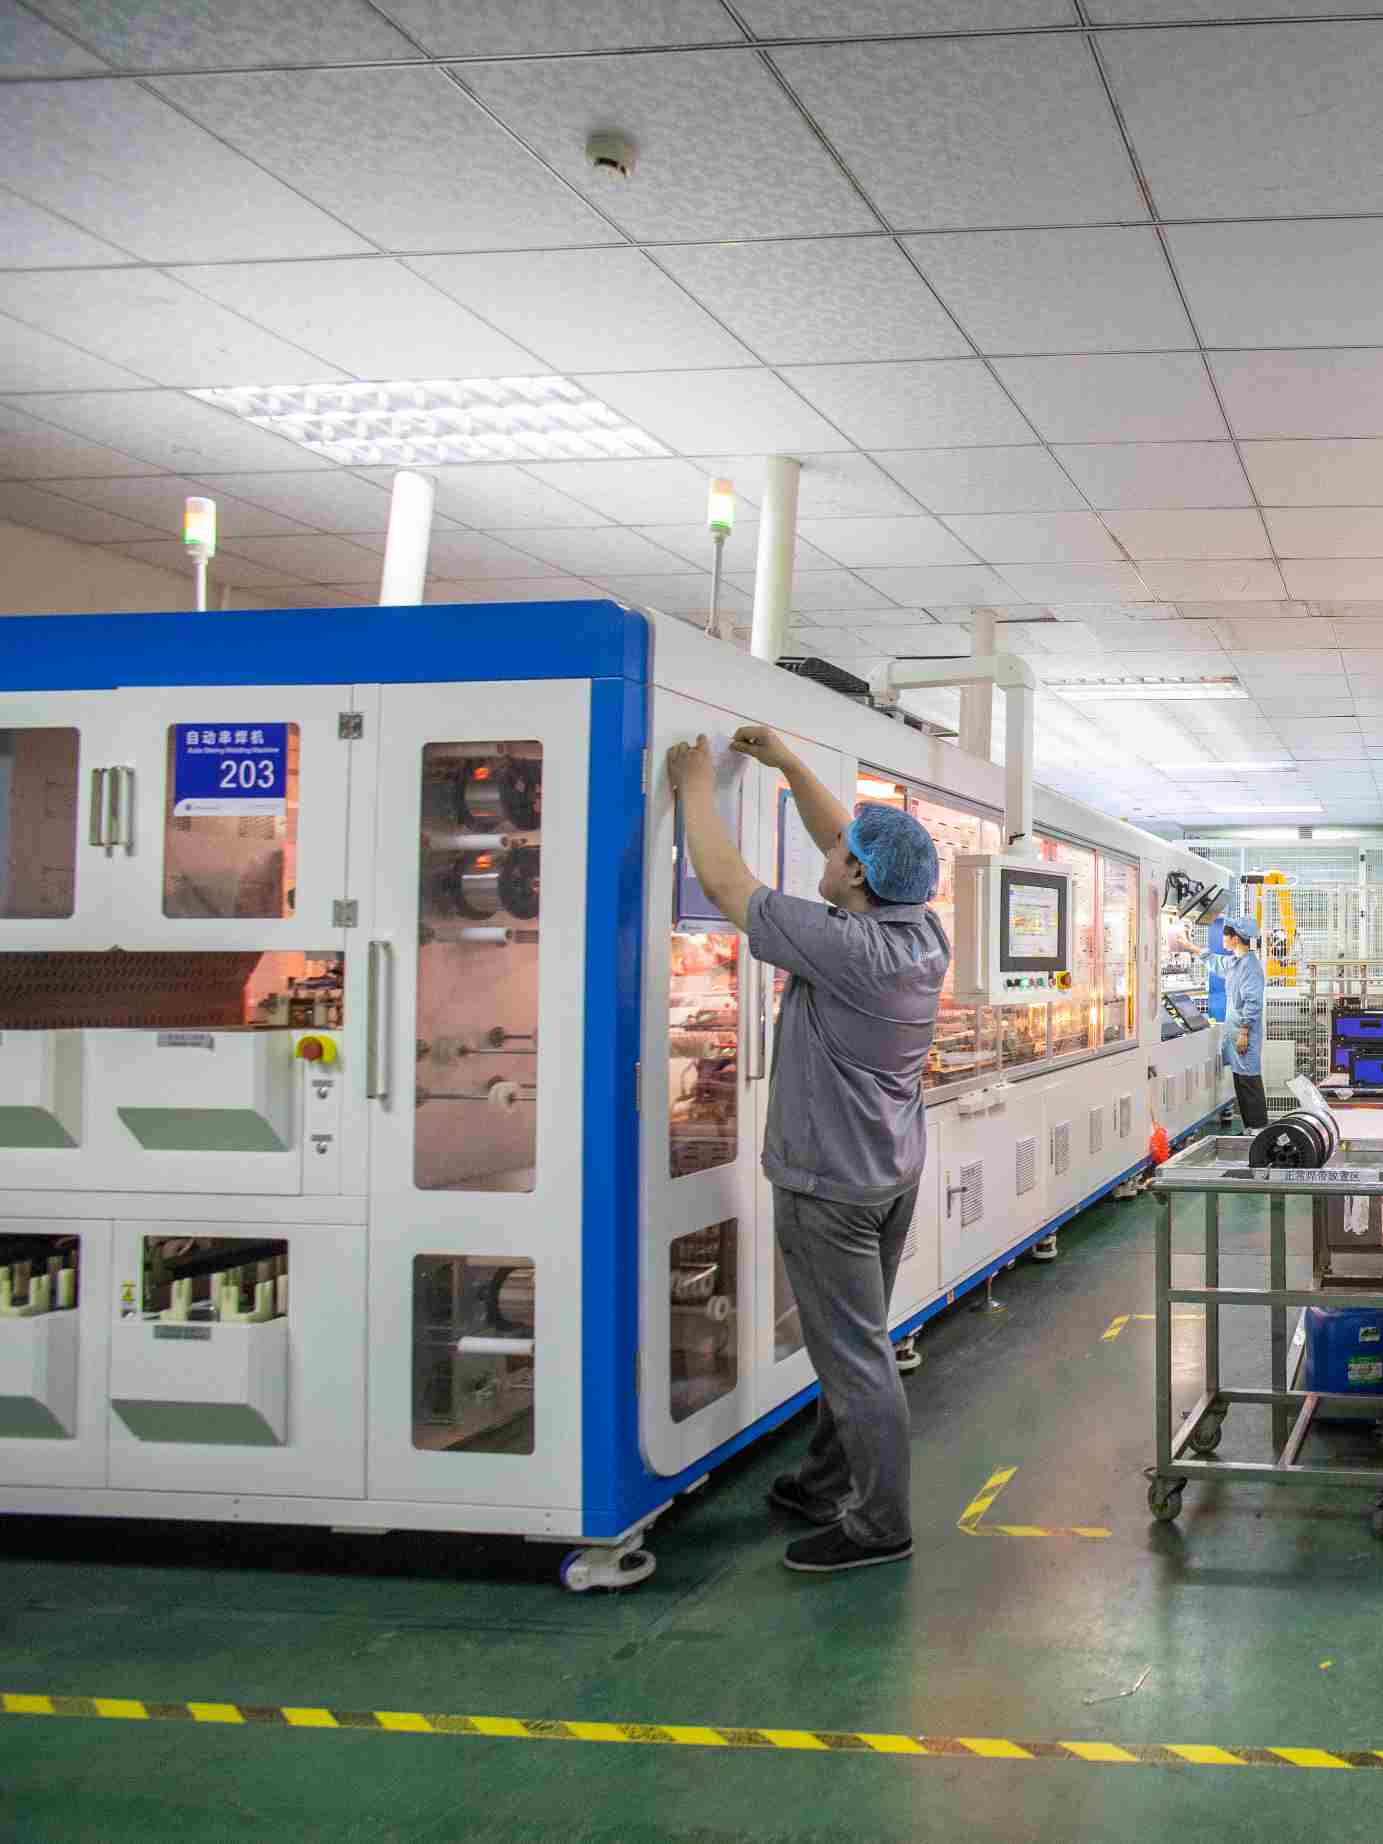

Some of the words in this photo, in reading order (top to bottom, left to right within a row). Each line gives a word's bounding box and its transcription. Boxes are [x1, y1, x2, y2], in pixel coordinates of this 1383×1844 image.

[186, 730, 265, 745] 自动串焊机
[219, 760, 275, 788] 203
